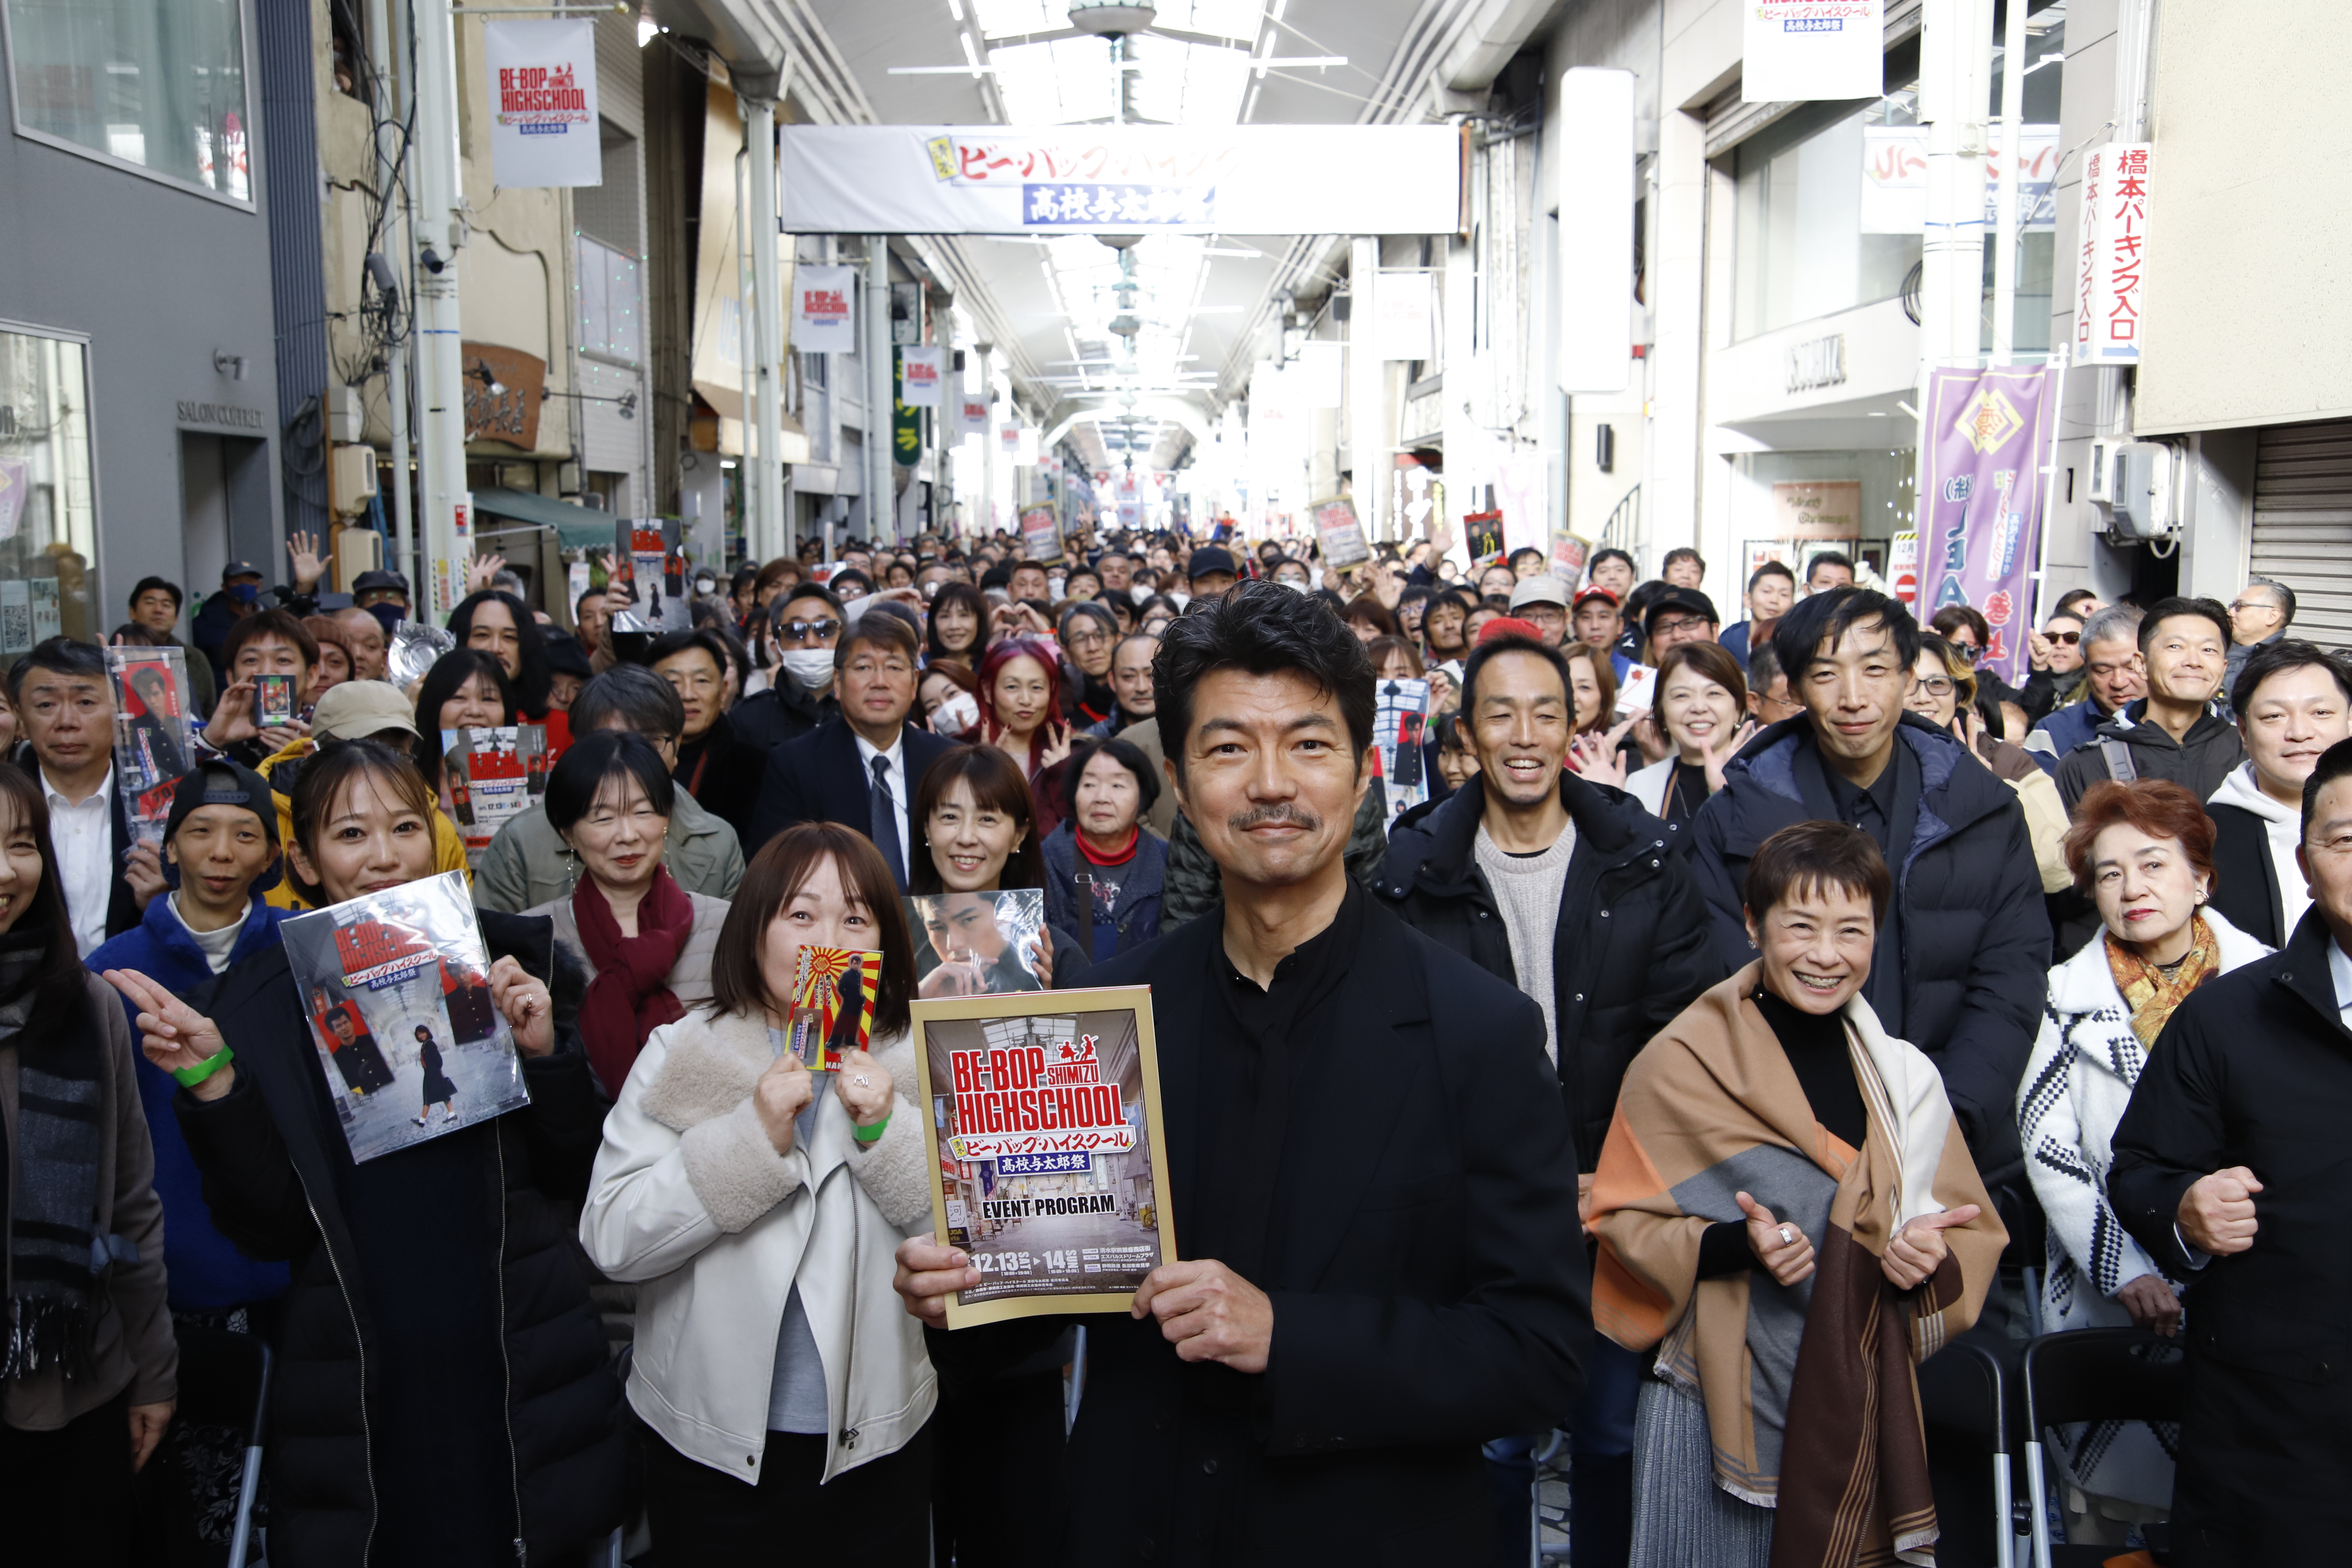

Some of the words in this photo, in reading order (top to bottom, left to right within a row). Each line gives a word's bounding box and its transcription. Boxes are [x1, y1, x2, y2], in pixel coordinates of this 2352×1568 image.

[500, 67, 547, 89] BE-BOP
[501, 89, 587, 112] HIGHSCHOOL
[2079, 152, 2101, 343] 橋本パーキング入口
[2109, 149, 2148, 341] 橋本パーキング入口
[177, 400, 216, 424] SALON
[334, 919, 386, 952] BE-BOP
[350, 951, 436, 985] ビー・バップ・ハイスクール
[951, 1047, 1046, 1092] BE-BOP
[1047, 1064, 1099, 1086] SHIMIZU
[957, 1085, 1127, 1135] HIGHSCHOOL
[953, 1139, 965, 1155] 清水
[965, 1130, 1130, 1156] ビー・バップ・ハイスクール
[983, 1199, 1031, 1219] EVENT
[1035, 1194, 1115, 1215] PROGRAM
[971, 1252, 1019, 1272] 12.13
[1018, 1251, 1032, 1269] SAT
[1042, 1250, 1066, 1269] 14
[1066, 1250, 1079, 1269] SUN
[1099, 1245, 1151, 1253] 清水駅前銀座商店街
